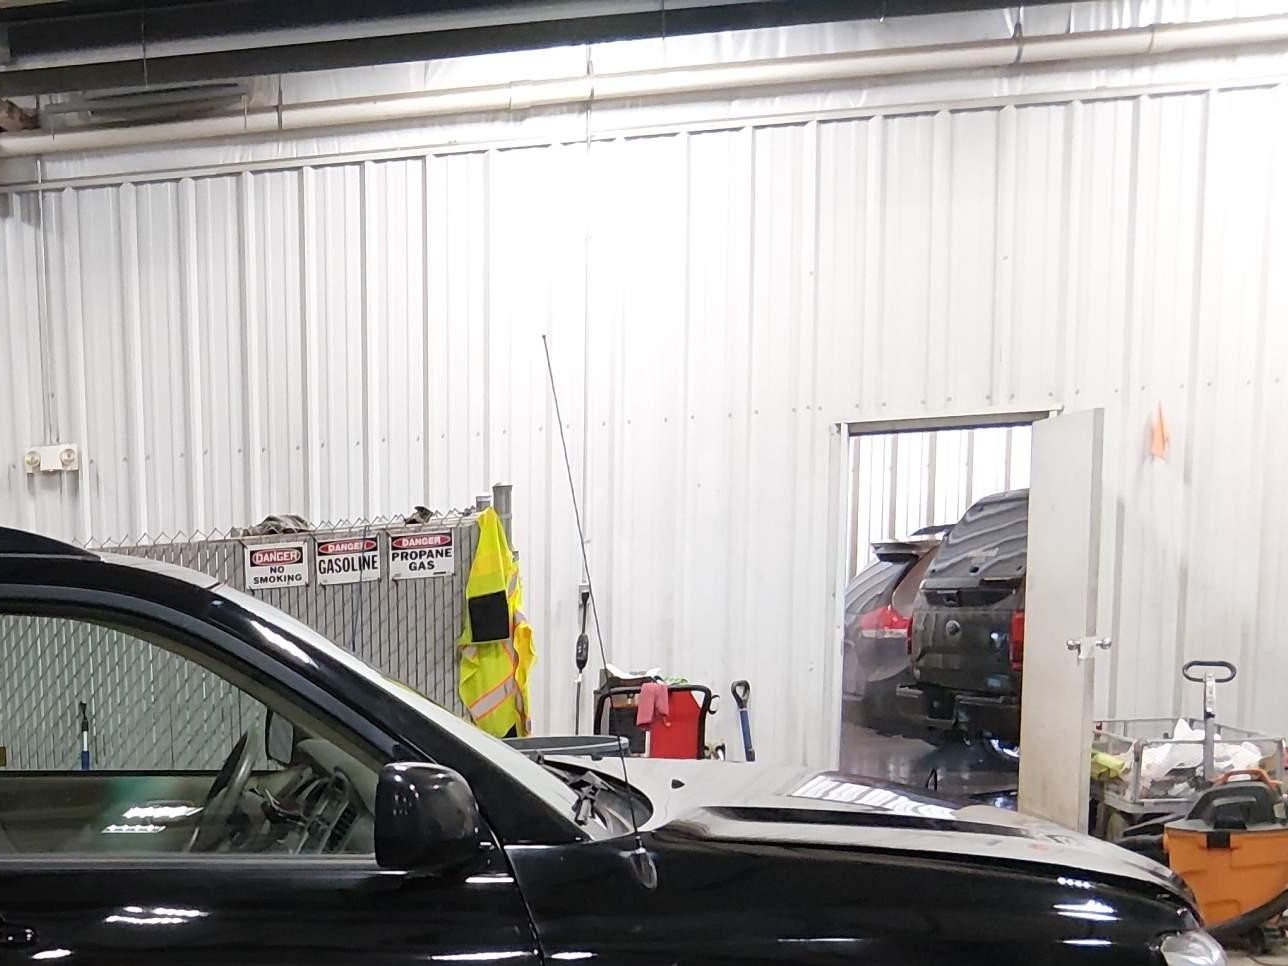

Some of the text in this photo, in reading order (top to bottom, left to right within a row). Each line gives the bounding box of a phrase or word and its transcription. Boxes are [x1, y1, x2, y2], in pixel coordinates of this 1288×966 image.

[402, 536, 441, 547] DANGER
[255, 551, 298, 563] DANGER
[392, 548, 452, 561] PROPANE
[270, 566, 285, 574] NO
[318, 555, 378, 575] GASOLINE
[408, 561, 435, 571] GAS
[253, 574, 302, 585] SMOKING
